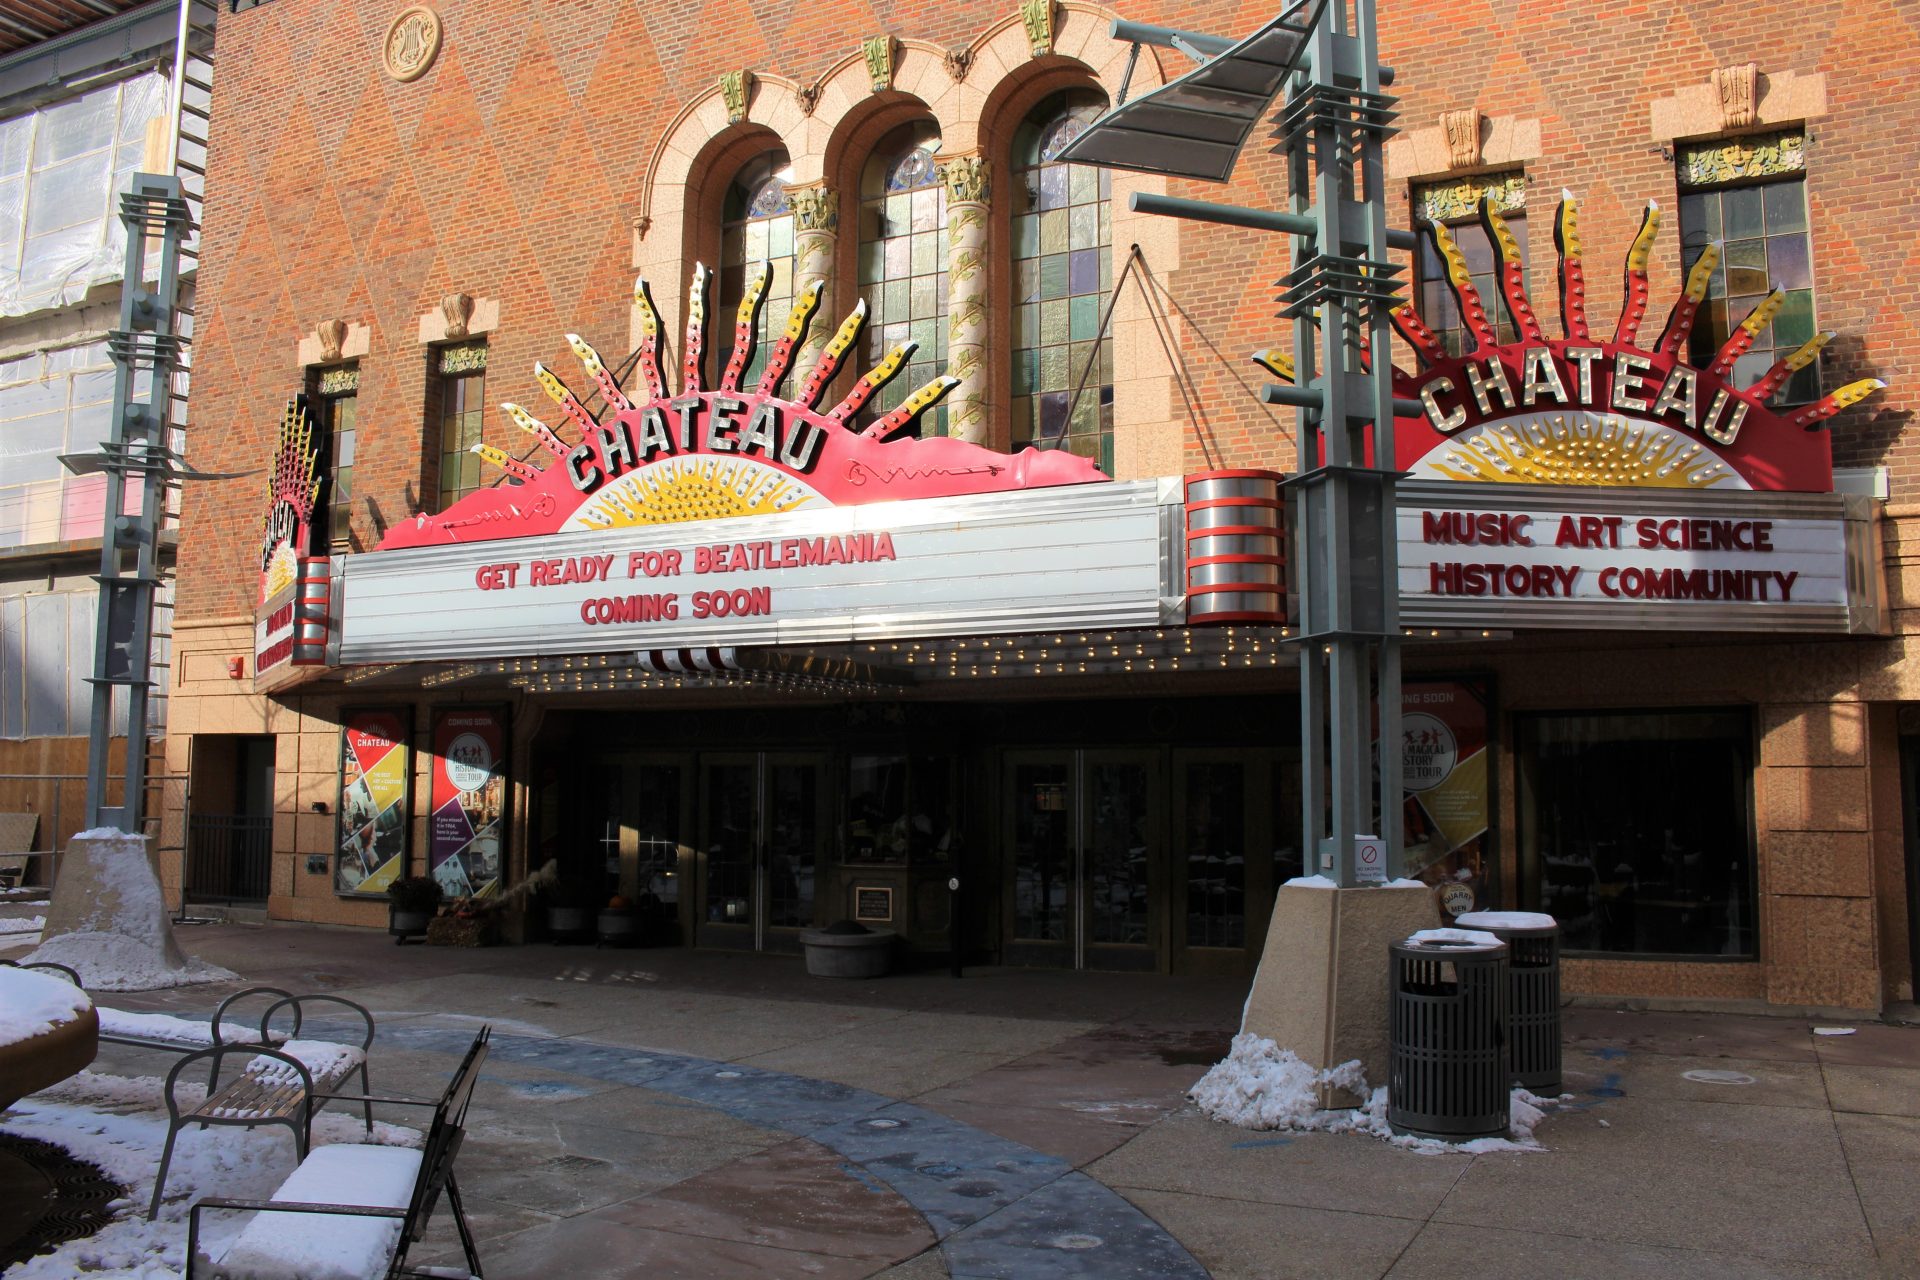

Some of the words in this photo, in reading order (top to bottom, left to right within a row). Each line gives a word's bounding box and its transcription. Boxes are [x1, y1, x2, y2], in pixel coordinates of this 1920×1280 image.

[1420, 346, 1749, 446] CHATEAU
[565, 398, 827, 492] CHATEAU
[1422, 511, 1534, 546] MUSIC
[1555, 516, 1622, 549] ART
[1636, 519, 1774, 552] SCIENCE
[475, 562, 520, 591] GET
[530, 554, 615, 587] READY
[628, 549, 681, 578] FOR
[695, 532, 896, 574] BEATLEMANIA
[1430, 562, 1580, 597] HISTORY
[1598, 567, 1798, 601] COMMUNITY
[580, 592, 678, 625] COMING
[693, 587, 771, 619] SOON
[1424, 692, 1455, 703] SOON
[448, 718, 473, 726] COMING
[474, 718, 492, 726] SOON
[357, 738, 390, 747] CHATEAU
[1407, 744, 1445, 754] MAGICAL
[1403, 755, 1434, 765] STORY
[468, 773, 482, 781] TOUR
[1416, 766, 1442, 777] TOUR
[1443, 891, 1473, 905] QUARRY
[1451, 905, 1467, 913] MEN
